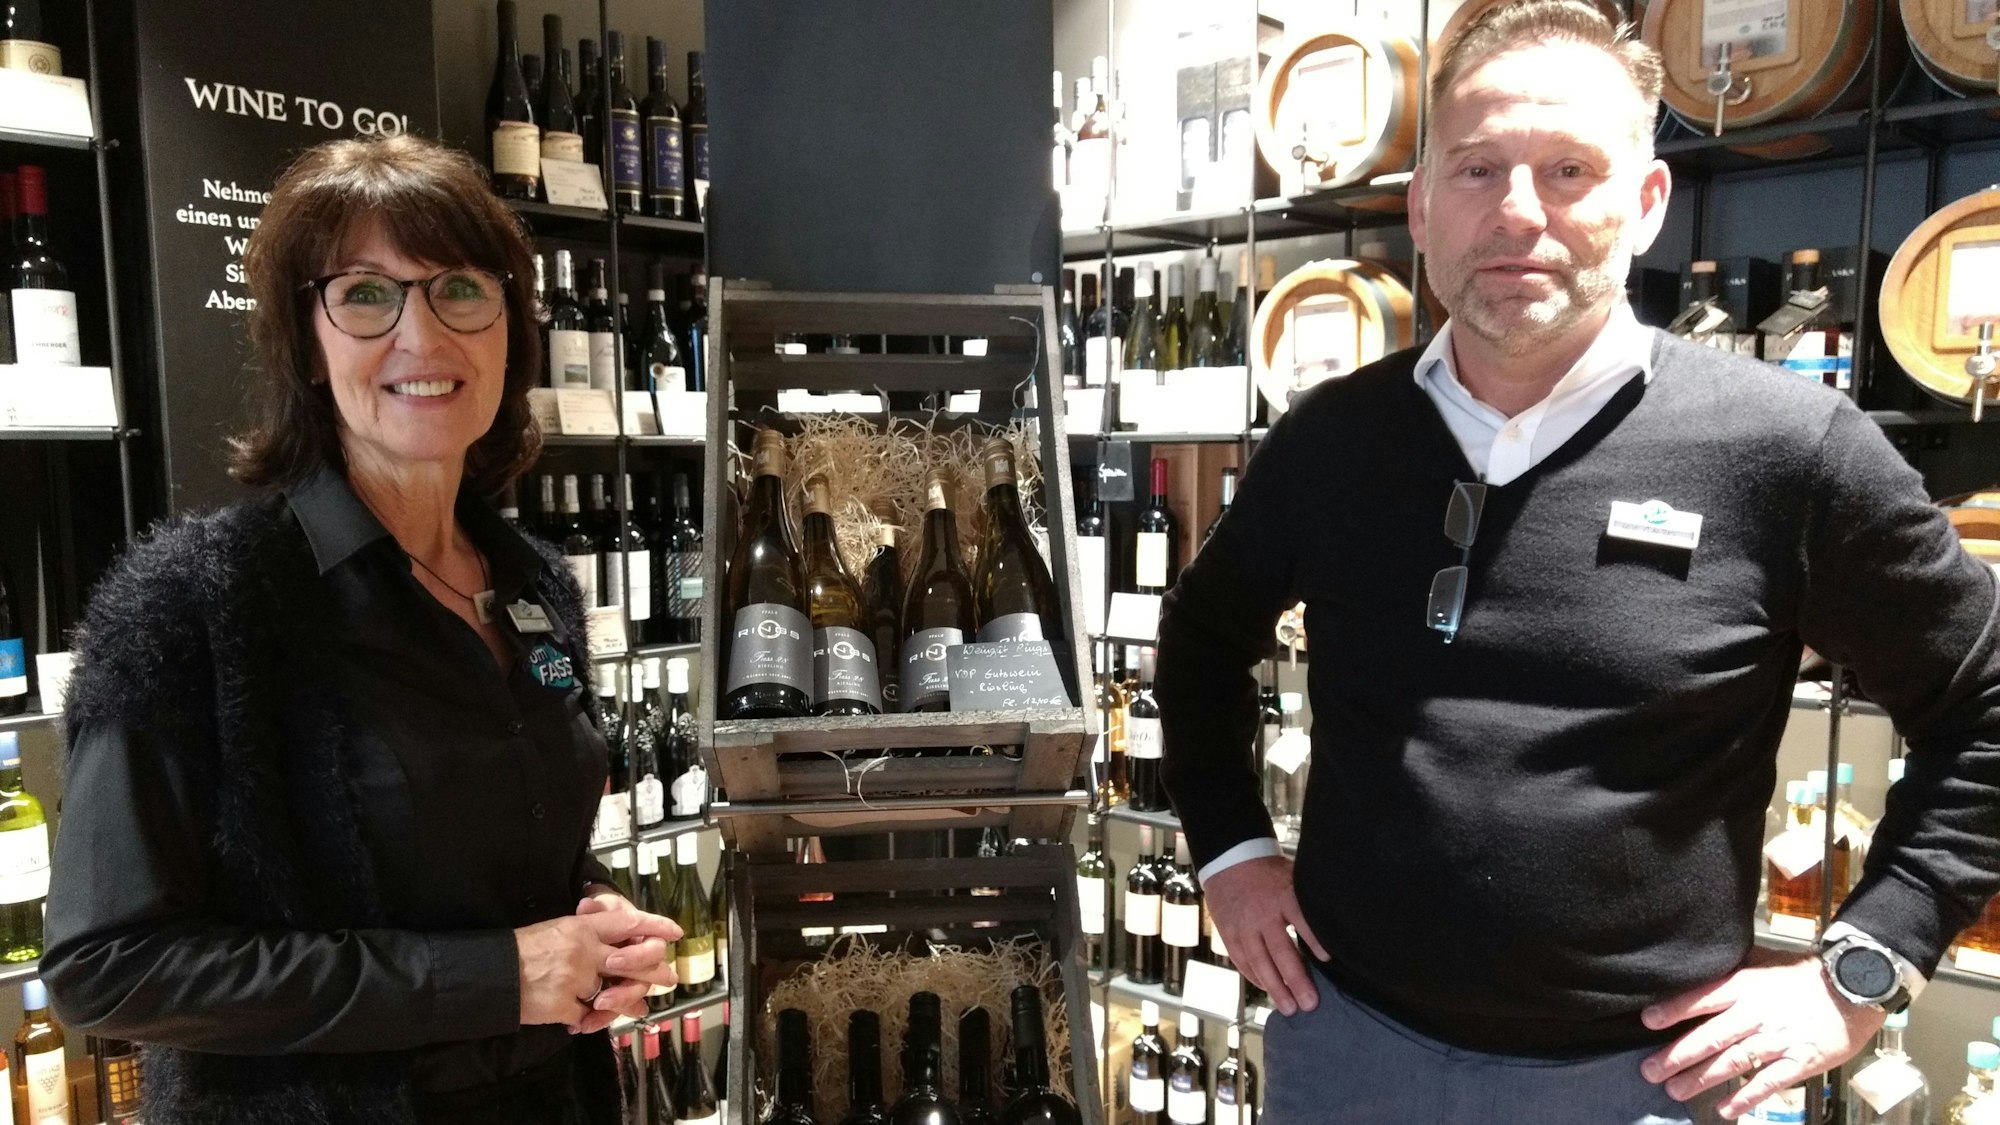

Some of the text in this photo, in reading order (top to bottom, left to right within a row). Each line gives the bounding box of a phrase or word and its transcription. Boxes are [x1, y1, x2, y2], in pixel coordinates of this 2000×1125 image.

[184, 77, 408, 138] WINE TO GO!
[176, 203, 232, 228] einen
[738, 619, 800, 640] RINGS
[813, 641, 871, 663] RINGS
[1015, 643, 1049, 657] Rings
[539, 656, 574, 687] FASS
[955, 665, 1042, 680] VDP Gutswein
